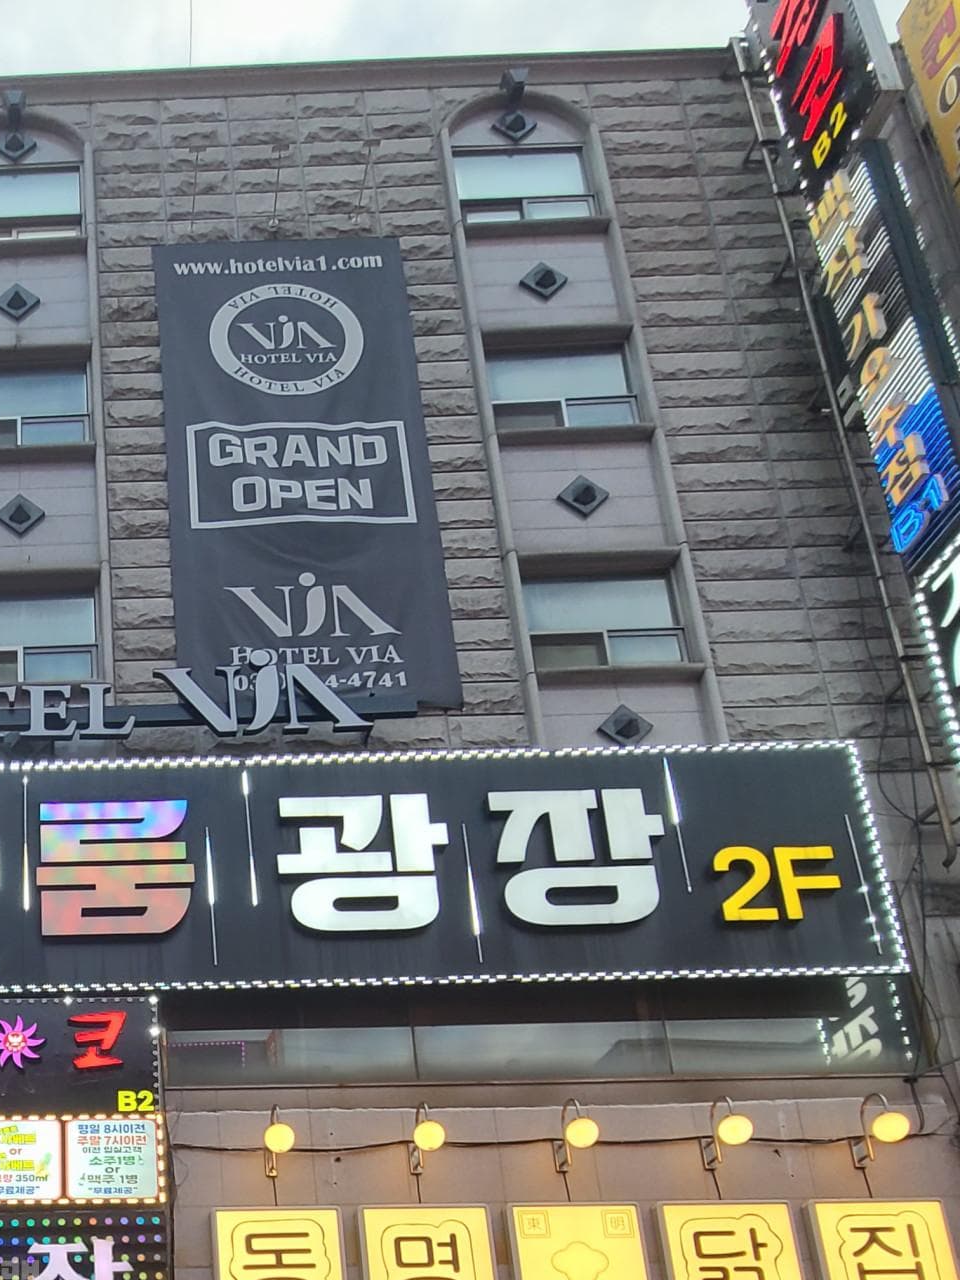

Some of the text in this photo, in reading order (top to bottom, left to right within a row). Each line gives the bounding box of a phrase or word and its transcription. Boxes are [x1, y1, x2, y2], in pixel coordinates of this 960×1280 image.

[812, 102, 848, 169] B2
[174, 255, 383, 275] www.hotelvia1.com
[240, 353, 337, 364] HOTEL VIA
[234, 366, 345, 392] HOTEL VIA
[208, 433, 388, 467] GRAND
[231, 476, 374, 513] OPEN
[345, 644, 404, 665] VIA
[713, 845, 841, 923] 2F
[117, 1090, 155, 1112] B2
[78, 1123, 147, 1135] 평일 8시이전
[77, 1135, 147, 1146] 주말 7시이전
[9, 1148, 22, 1156] or
[105, 1166, 121, 1174] or
